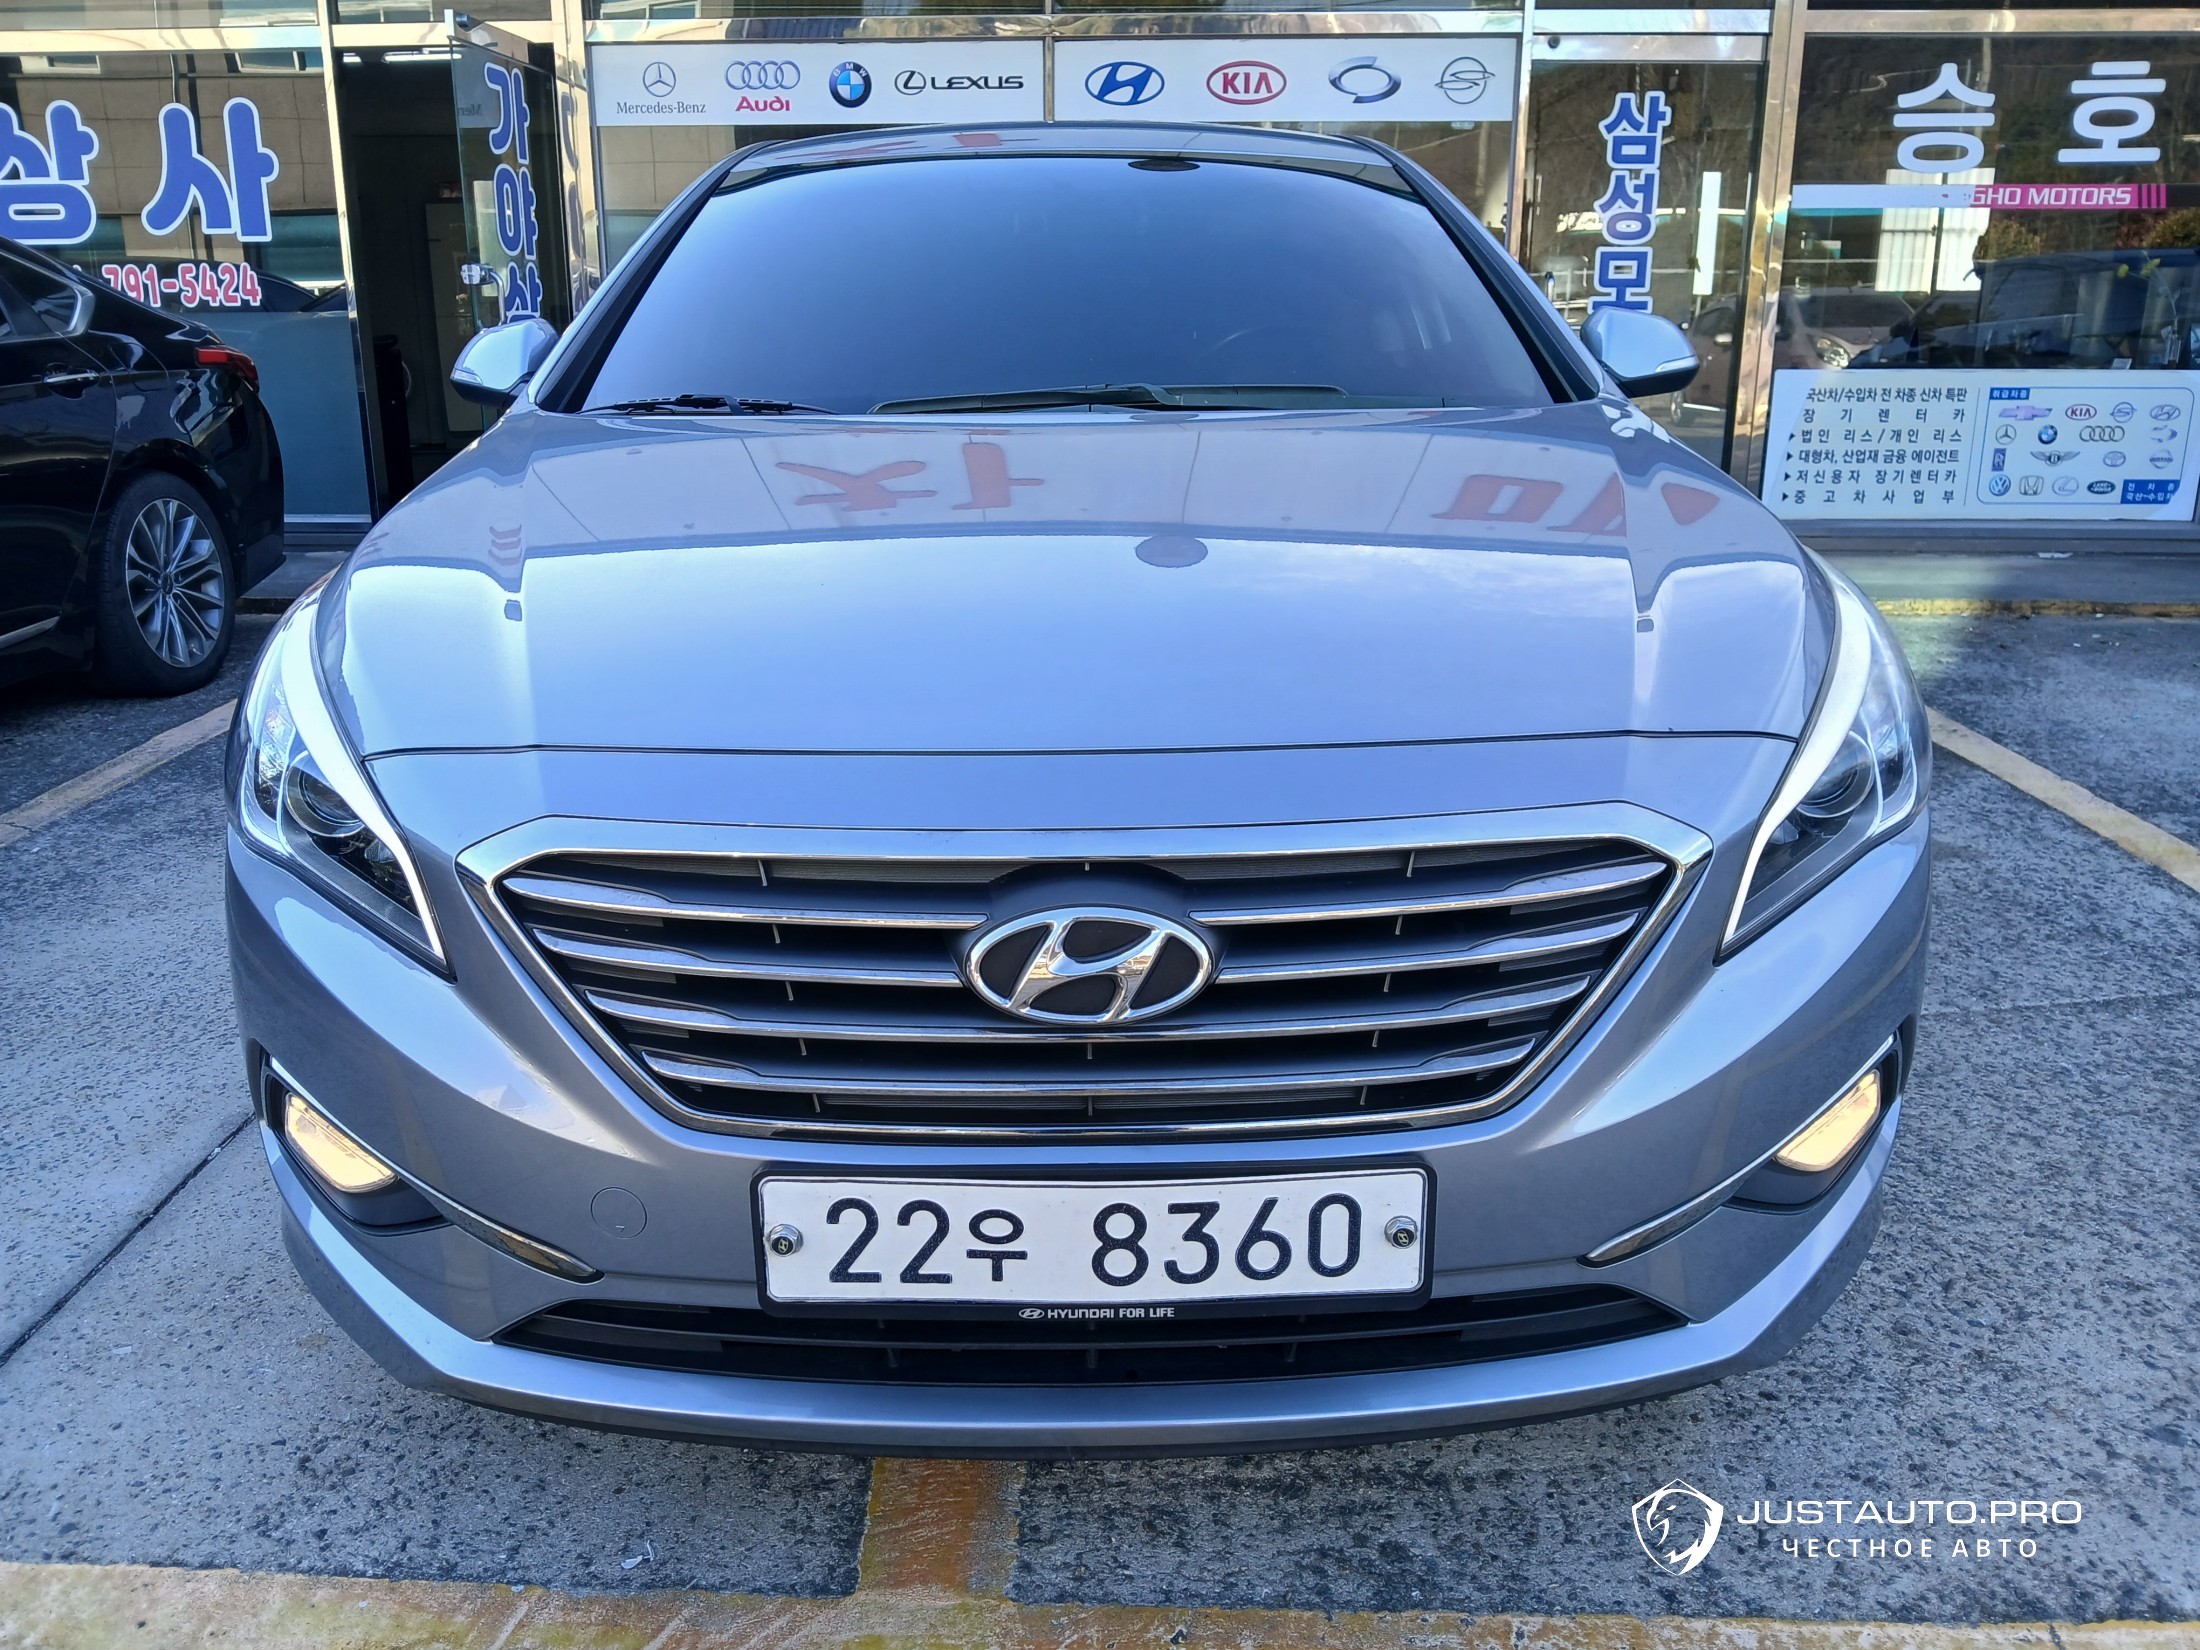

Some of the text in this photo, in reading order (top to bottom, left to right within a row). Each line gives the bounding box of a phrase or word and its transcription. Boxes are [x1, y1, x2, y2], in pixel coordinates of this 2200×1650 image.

[832, 62, 868, 78] BMW
[931, 75, 1024, 90] LEXUS
[1221, 72, 1274, 96] KIA
[616, 101, 706, 114] Mercedes-Benz
[735, 95, 791, 112] Audi
[2027, 187, 2132, 205] MOTORS
[101, 262, 261, 307] 791-5424
[1805, 387, 1878, 402] 국산차/수입차
[1894, 387, 1917, 402] 차종
[1919, 387, 1942, 402] 신차
[2069, 407, 2092, 417] KIA
[1801, 429, 1830, 444] 법인
[1933, 429, 1962, 444] 리스
[1842, 449, 1879, 464] 산업재
[1883, 449, 1907, 464] 금융
[1911, 449, 1959, 464] 에이전트
[825, 1192, 1362, 1287] 22우 8360
[1047, 1307, 1175, 1319] HYUNDAI FOR LIFE
